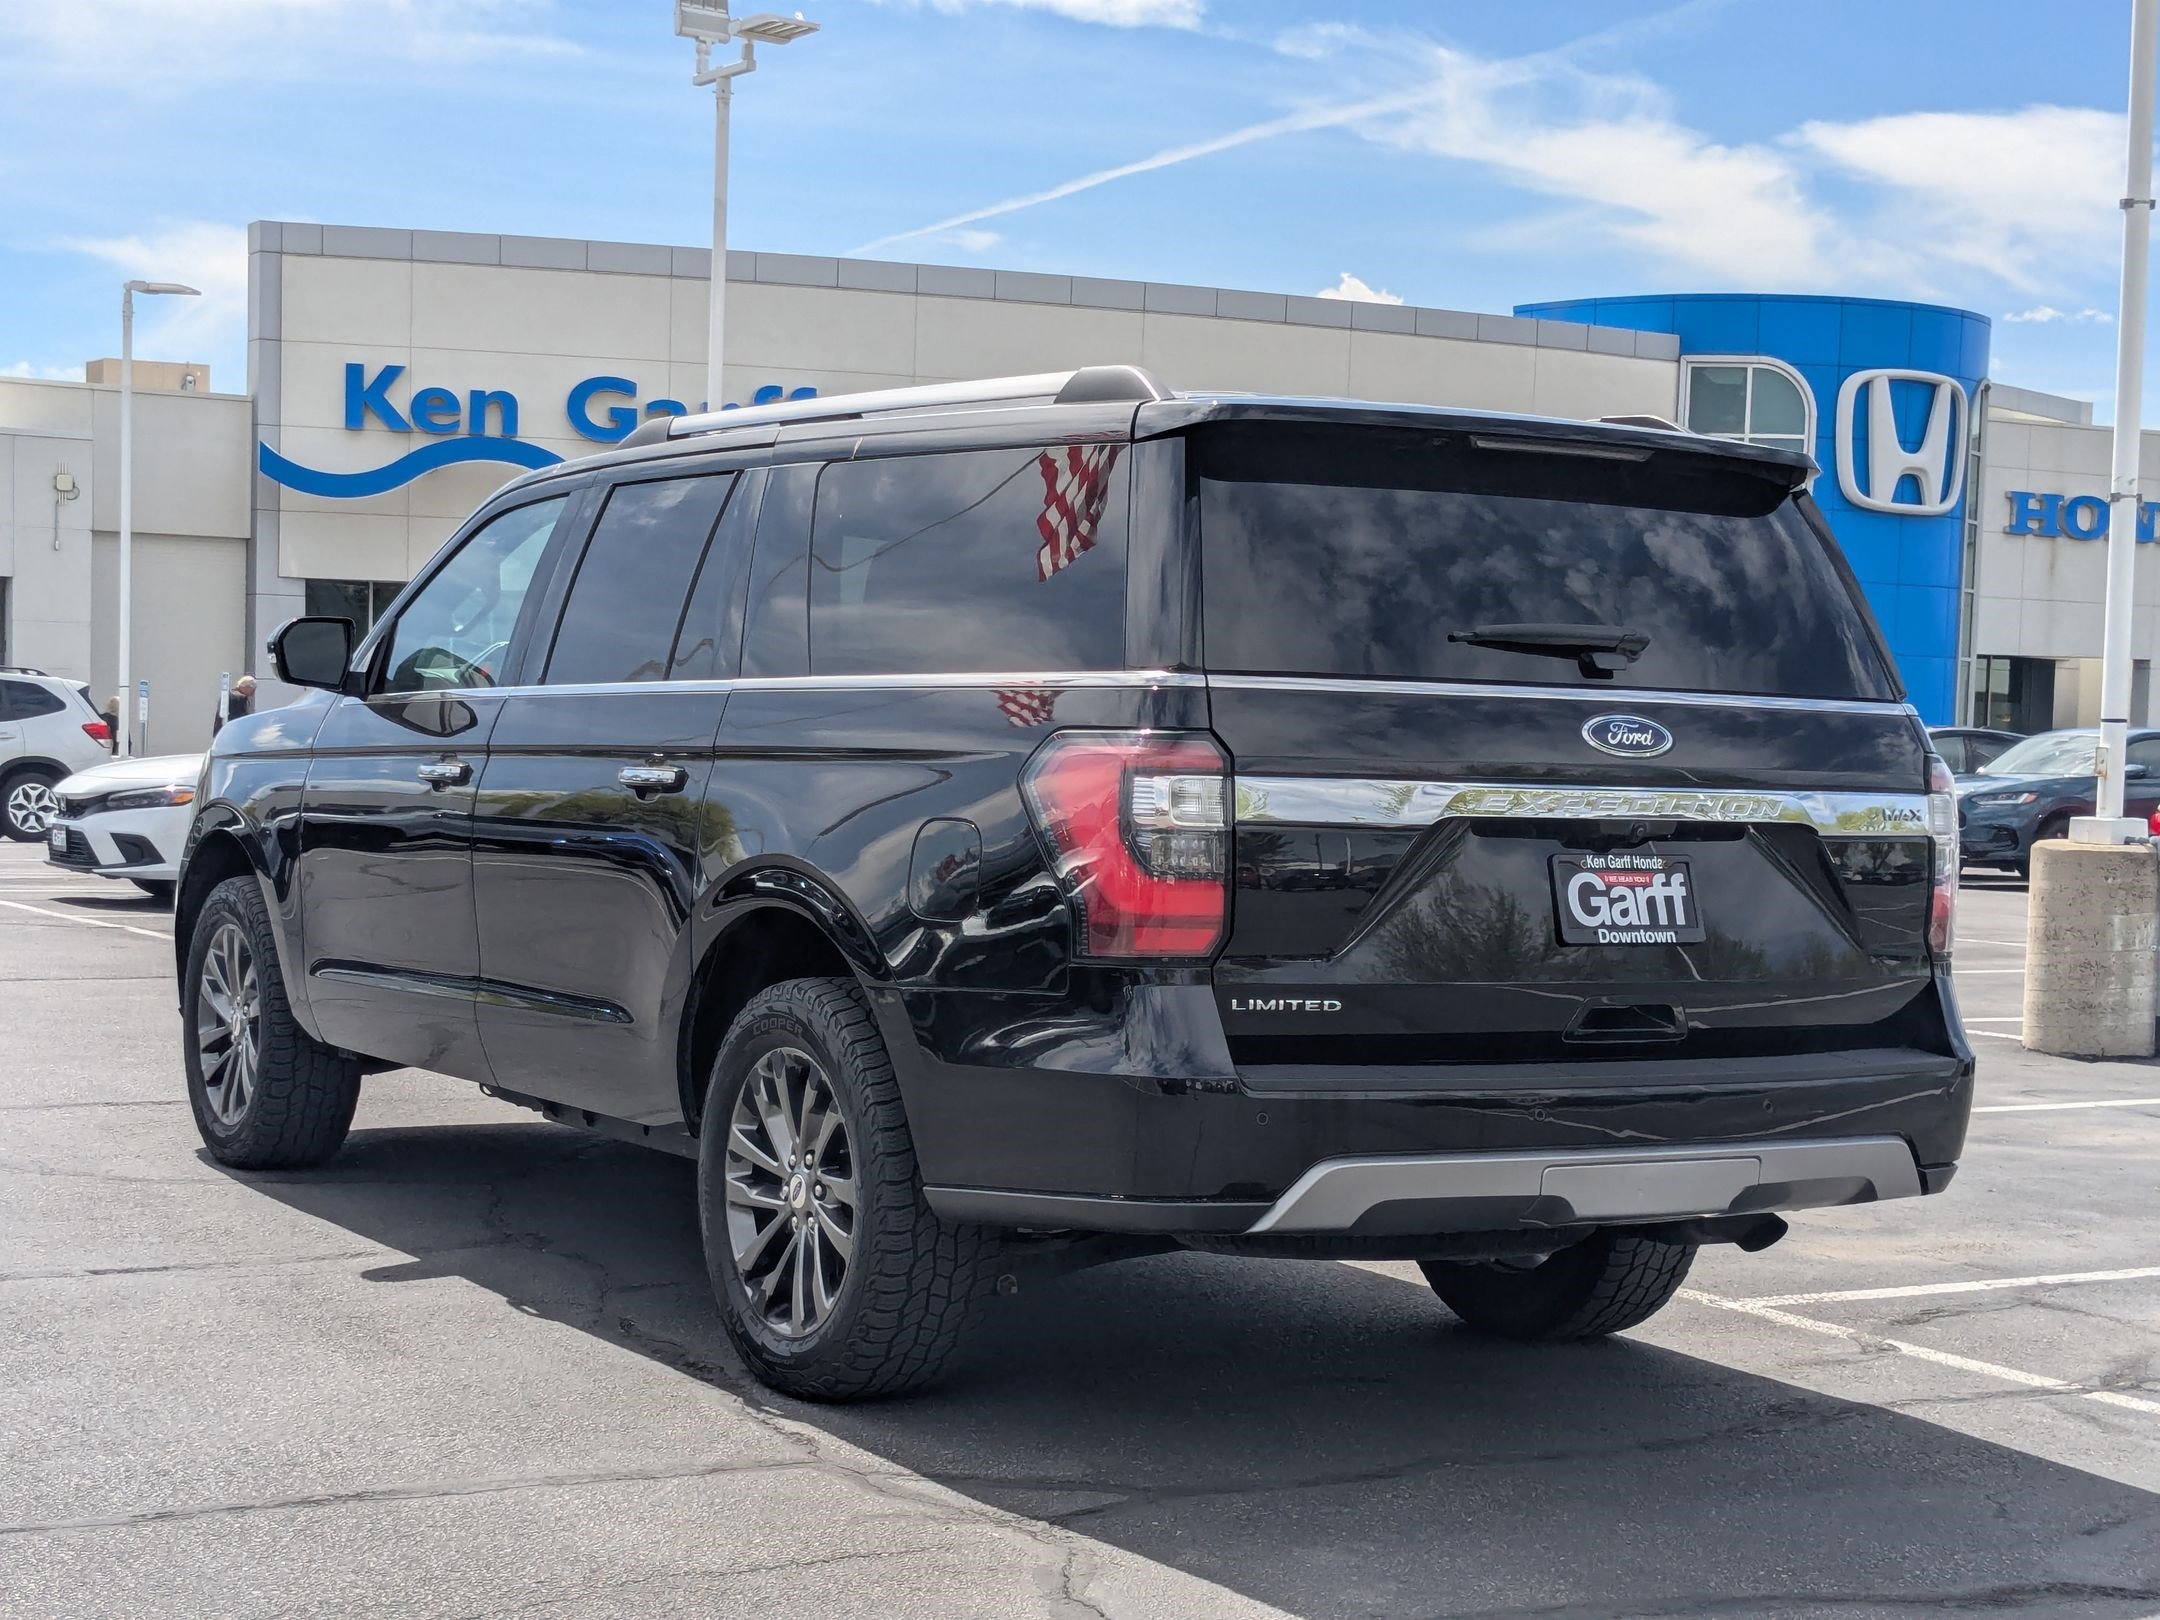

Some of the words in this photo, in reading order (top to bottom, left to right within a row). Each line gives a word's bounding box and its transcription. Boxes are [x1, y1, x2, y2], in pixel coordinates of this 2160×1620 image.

[345, 362, 519, 438] Ken
[1607, 721, 1654, 746] Ford
[1479, 792, 1784, 818] EXPEDITION
[1586, 854, 1606, 869] Ken
[1607, 854, 1631, 869] Garff
[1632, 855, 1664, 869] Honda
[1567, 872, 1687, 927] Garff
[1598, 929, 1677, 943] Downtown
[1231, 998, 1342, 1012] LIMITED
[753, 1017, 803, 1036] COOPER
